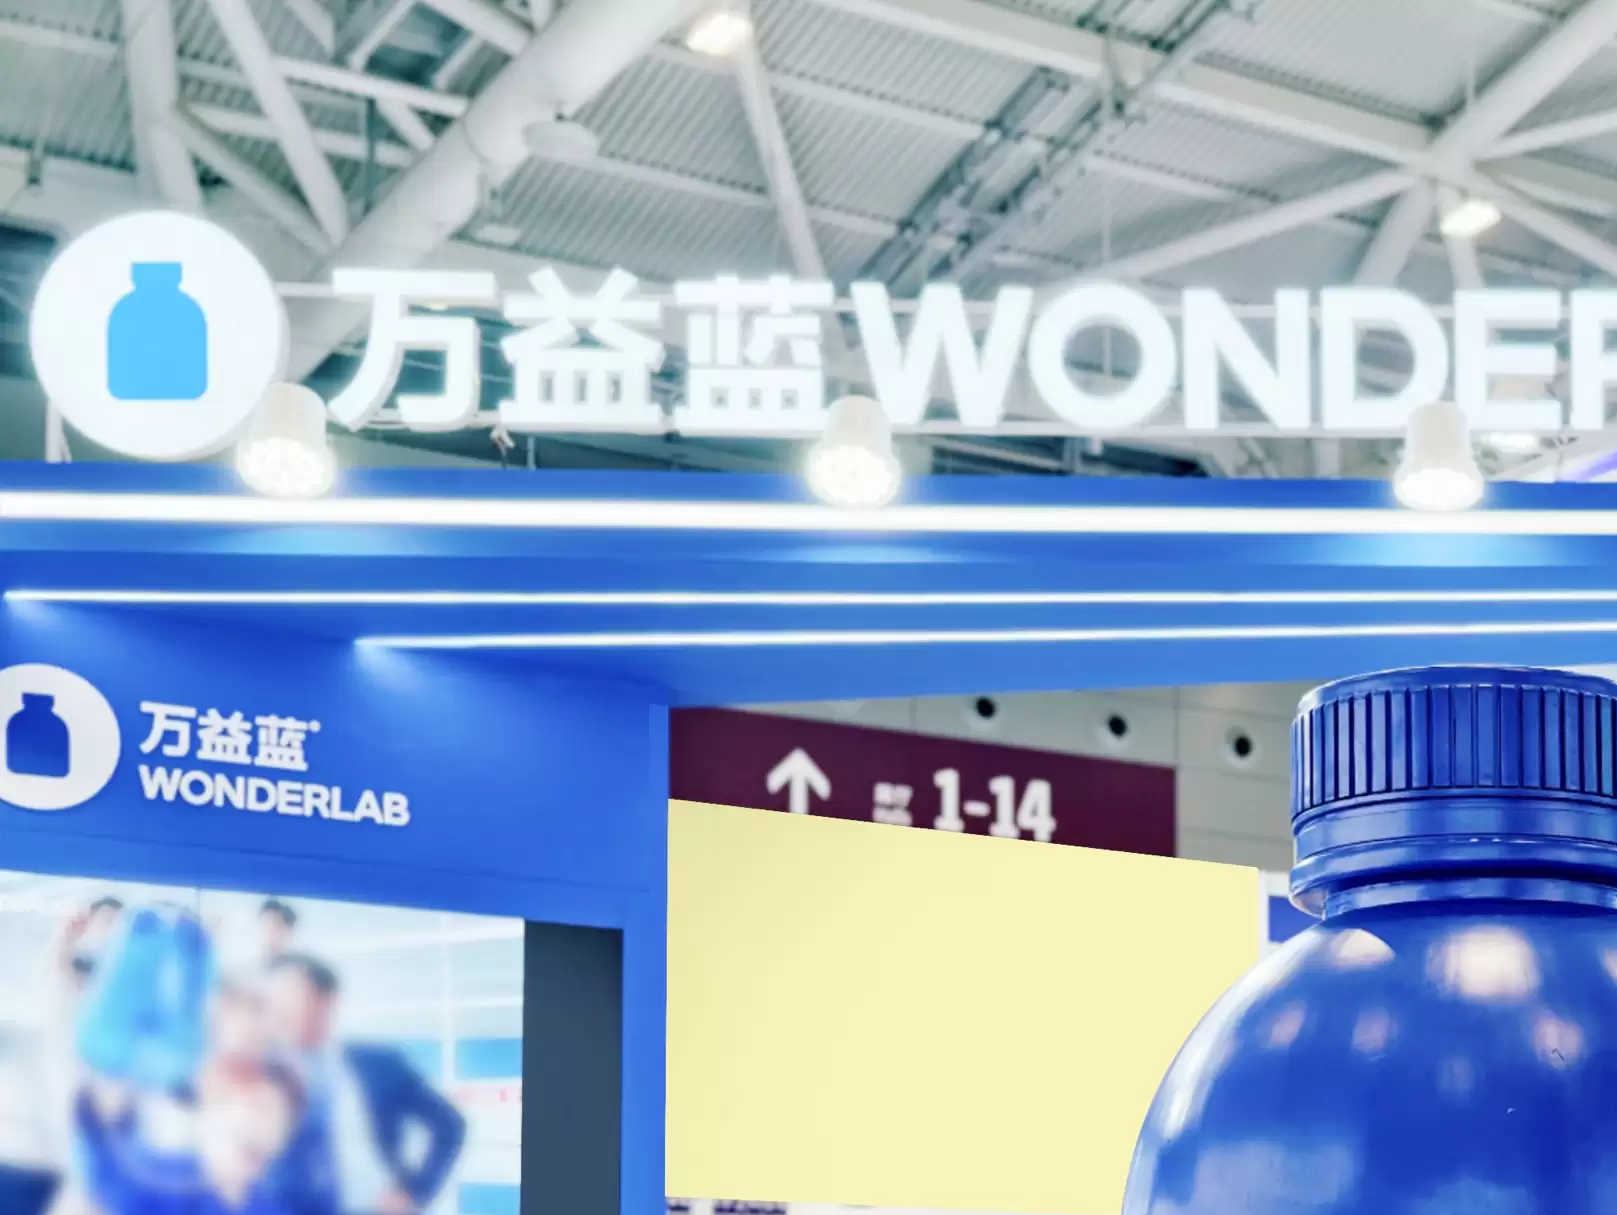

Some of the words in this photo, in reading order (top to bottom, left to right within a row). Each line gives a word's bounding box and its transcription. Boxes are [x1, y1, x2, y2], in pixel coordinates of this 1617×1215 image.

[328, 266, 836, 435] 万益蓝
[137, 763, 411, 827] WONDERLAB
[933, 768, 1057, 842] 1-14
